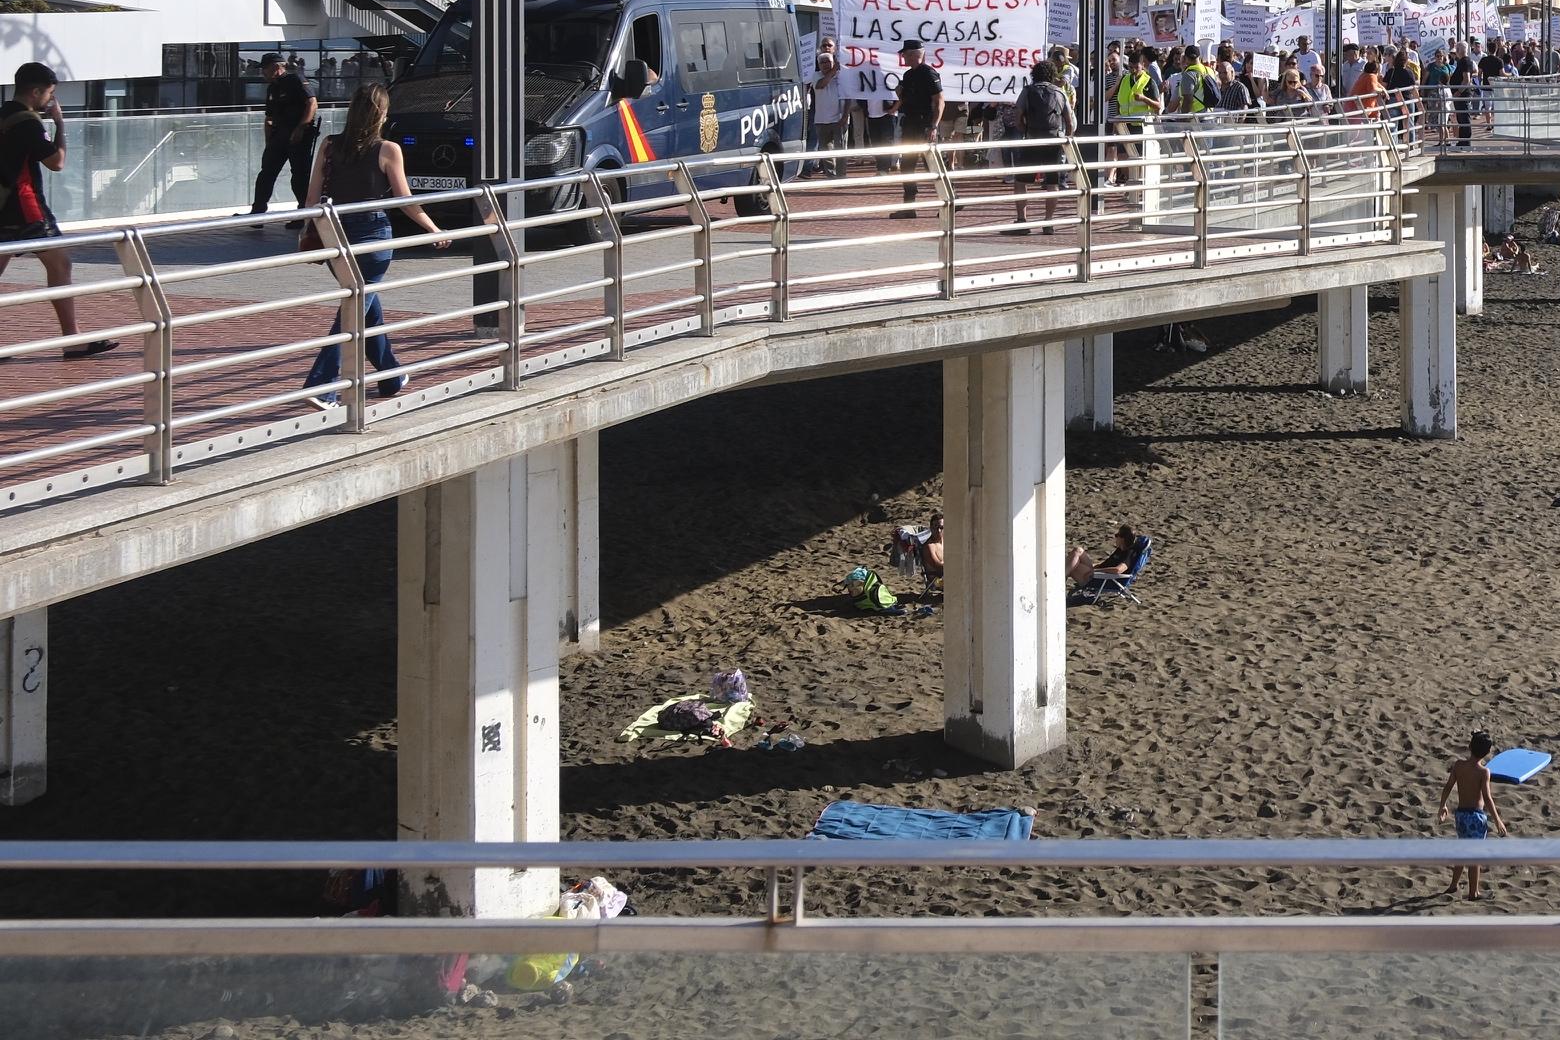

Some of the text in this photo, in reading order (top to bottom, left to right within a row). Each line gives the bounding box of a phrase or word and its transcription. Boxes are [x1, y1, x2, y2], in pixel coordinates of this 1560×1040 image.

[852, 16, 903, 41] LAS
[1377, 16, 1394, 26] NO
[845, 46, 1041, 69] DE LS TORRES
[860, 70, 901, 92] NO
[741, 85, 802, 144] POLICIA
